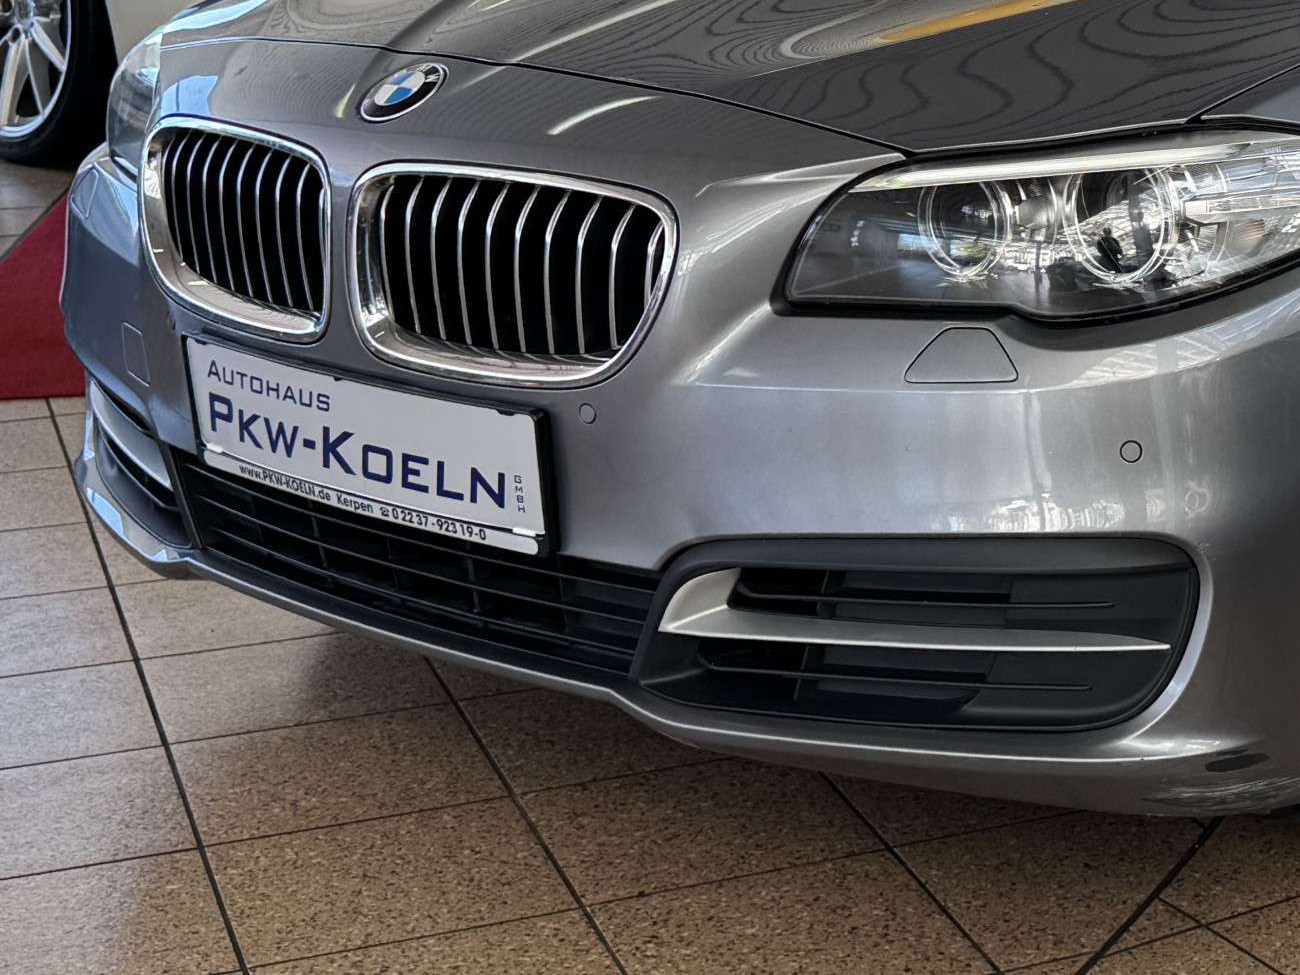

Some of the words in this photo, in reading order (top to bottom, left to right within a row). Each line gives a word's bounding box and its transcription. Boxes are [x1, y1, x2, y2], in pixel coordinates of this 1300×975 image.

[207, 359, 331, 412] AUTOHAUS
[208, 391, 506, 509] PKW-KOELN
[238, 464, 332, 501] www.PKW-KOELN.de
[336, 494, 374, 513] Kerpen
